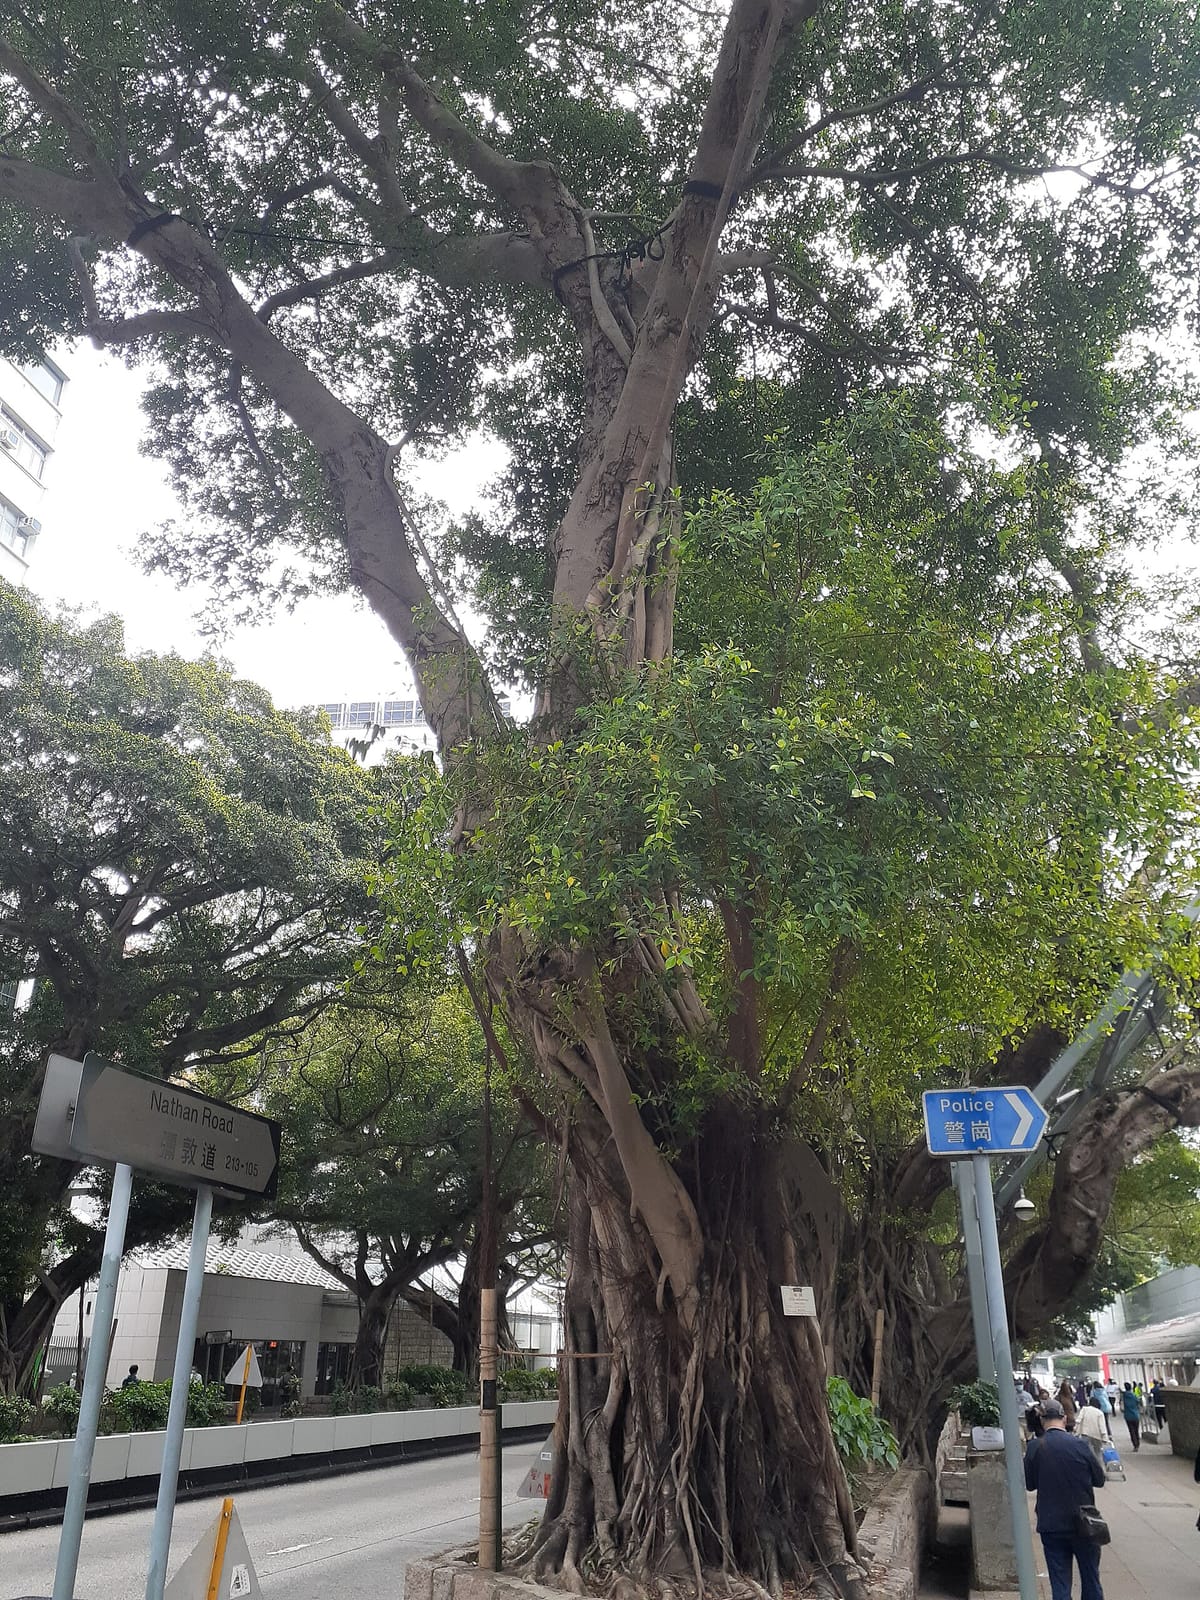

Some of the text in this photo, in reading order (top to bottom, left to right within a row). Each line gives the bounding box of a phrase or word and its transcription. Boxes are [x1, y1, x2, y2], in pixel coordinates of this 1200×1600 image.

[150, 1089, 234, 1134] Nathan Road
[940, 1098, 994, 1113] Police
[944, 1120, 992, 1143] 警崗
